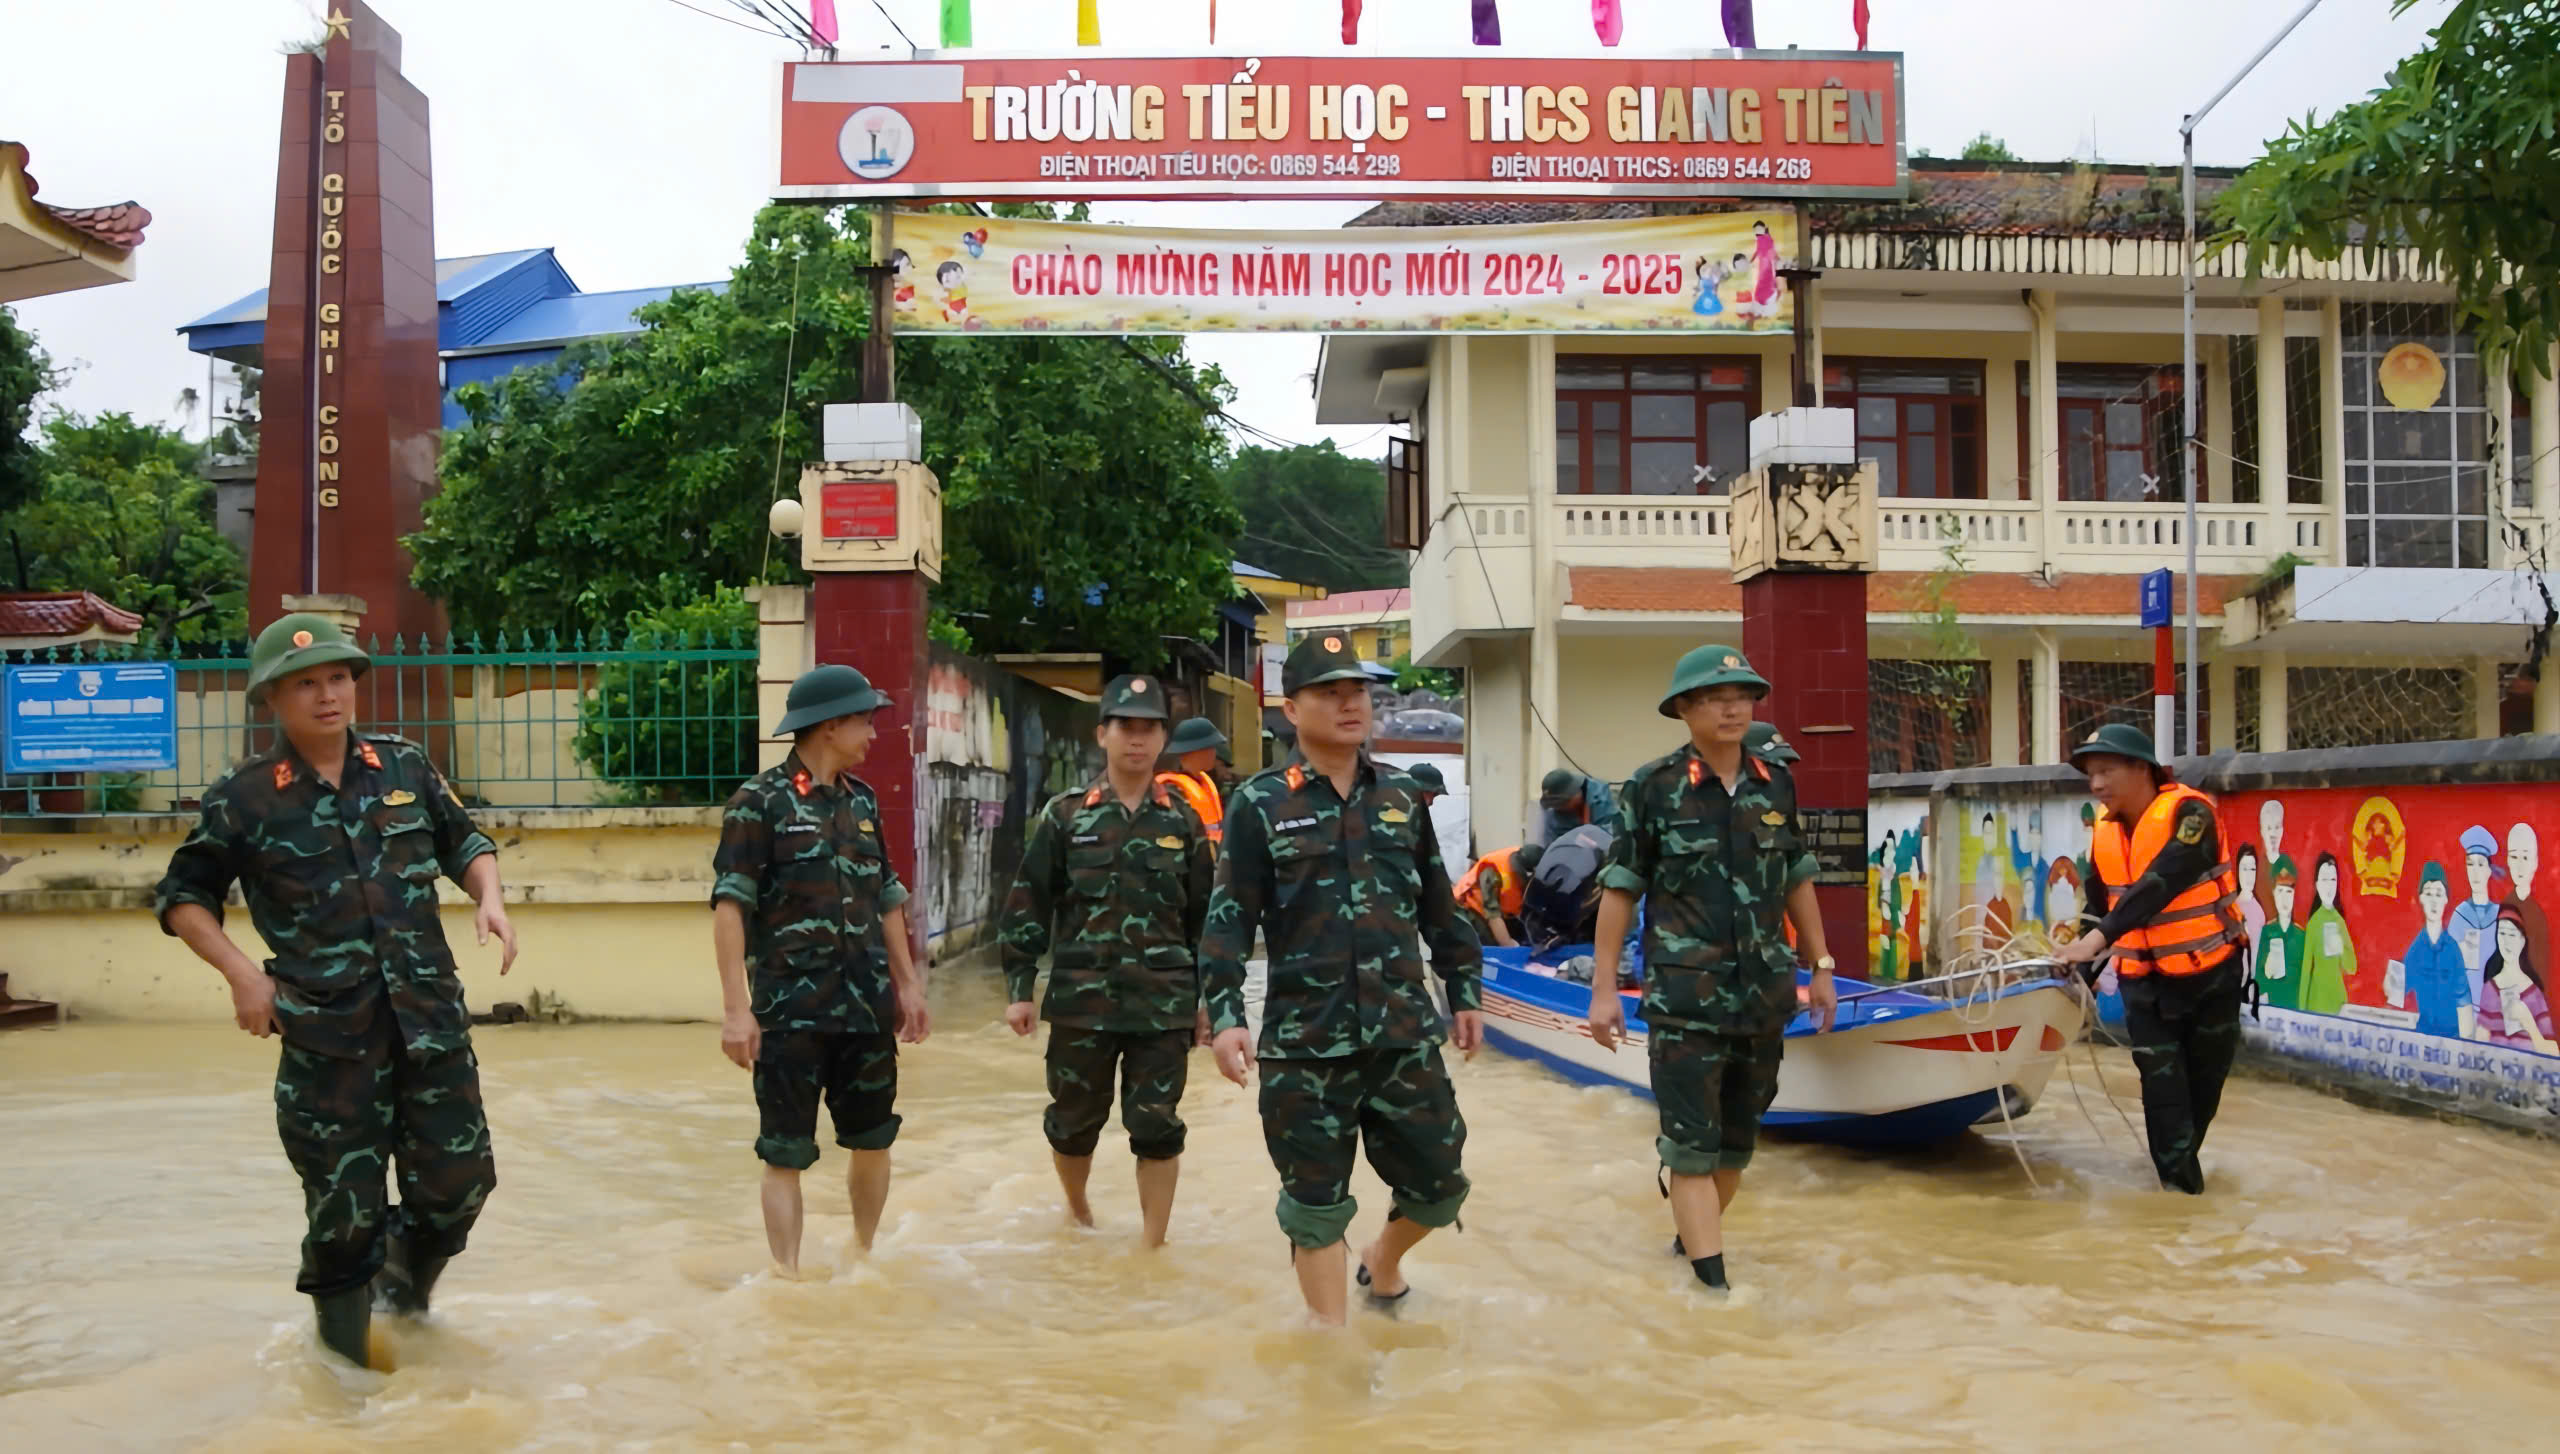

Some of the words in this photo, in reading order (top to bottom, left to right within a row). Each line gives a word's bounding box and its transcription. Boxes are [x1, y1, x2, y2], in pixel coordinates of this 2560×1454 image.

[324, 91, 345, 143] TỔ
[966, 70, 1165, 142] TRƯỜNG
[1182, 58, 1290, 140] TIỂU
[1309, 84, 1409, 153] HỌC
[1462, 85, 1590, 142] THCS
[1607, 85, 1762, 144] GIANG
[1777, 77, 1884, 145] TIÊN
[1040, 151, 1089, 181] ĐIỆN
[1093, 154, 1157, 180] THOẠI
[1270, 154, 1317, 176] 0869
[1323, 154, 1360, 176] 544
[1365, 154, 1400, 176] 298
[1492, 152, 1540, 181] ĐIỆN
[1544, 156, 1609, 181] THOẠI
[1684, 157, 1729, 179] 0869
[1734, 157, 1770, 179] 544
[1775, 157, 1811, 180] 268
[322, 173, 344, 274] QUỐC
[1012, 245, 1102, 296] CHÀO
[1116, 245, 1219, 296] MỪNG
[1231, 246, 1311, 297] NĂM
[1325, 252, 1392, 305] HỌC
[1405, 244, 1470, 296] MỚI
[1483, 253, 1565, 296] 2024
[1602, 253, 1682, 295] 2025
[320, 303, 340, 374] GHI
[319, 405, 339, 508] CÔNG
